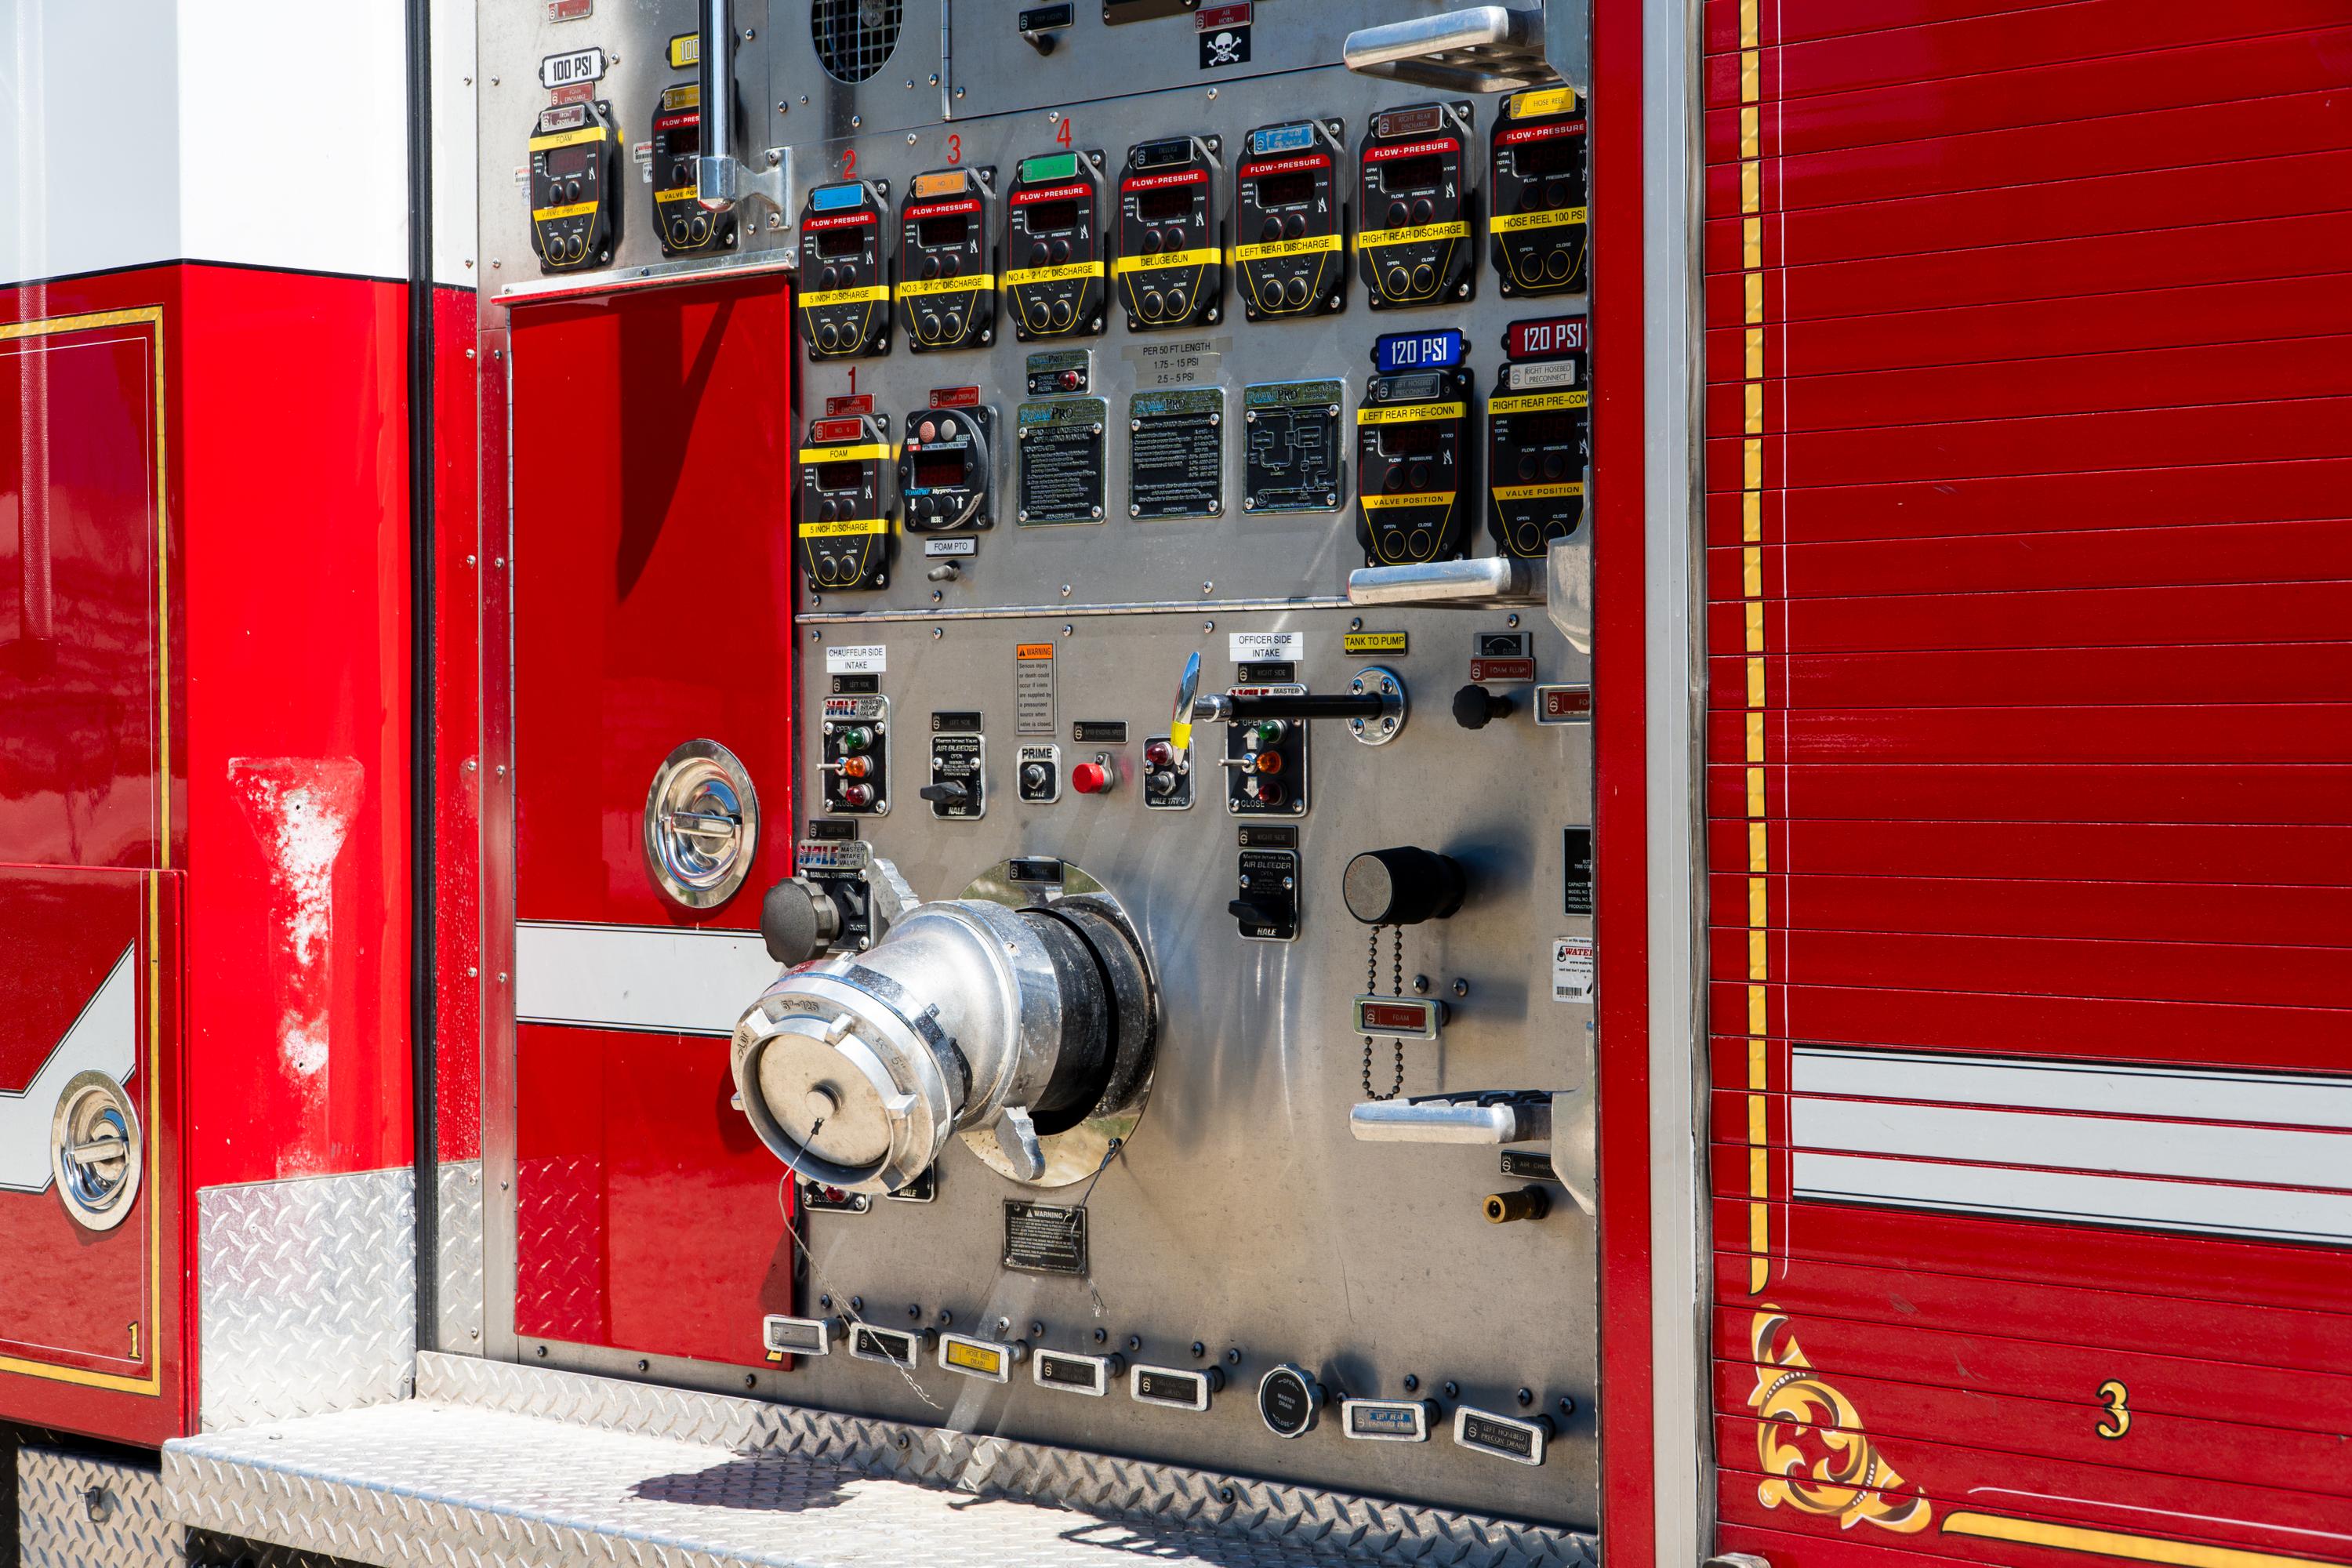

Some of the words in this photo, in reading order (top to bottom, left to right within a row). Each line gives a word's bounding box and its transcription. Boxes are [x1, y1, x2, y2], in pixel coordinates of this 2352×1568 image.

[553, 60, 571, 82] 100
[575, 57, 592, 79] PSI
[564, 93, 586, 103] DISCHARGE
[1534, 98, 1549, 107] HOSE
[1401, 121, 1428, 131] DISCHARGE
[1056, 118, 1073, 149] 4
[556, 135, 573, 145] FOAM
[947, 134, 961, 165] 3
[841, 149, 857, 180] 2
[664, 191, 684, 200] VALVE
[1504, 216, 1528, 227] HOSE
[1530, 212, 1552, 225] REEL
[1554, 211, 1570, 222] 100
[1571, 209, 1585, 220] PSI
[1362, 233, 1388, 245] RIGHT
[1389, 230, 1412, 241] REAR
[1414, 223, 1462, 238] DISCHARGE
[1240, 246, 1259, 257] LEFT
[1261, 243, 1283, 255] REAR
[1284, 238, 1330, 253] DISCHARGE
[1141, 255, 1171, 267] DELUGE
[1172, 253, 1189, 263] GUN
[1032, 270, 1036, 279] 2
[1051, 265, 1093, 277] DISCHARGE
[943, 278, 982, 289] DISCHARGE
[809, 295, 814, 303] 5
[815, 293, 830, 303] INCH
[832, 290, 869, 302] DISCHARGE
[1524, 326, 1550, 352] 120
[1555, 323, 1582, 349] PSI
[1160, 346, 1168, 354] 50
[1181, 342, 1210, 352] LENGTH
[1392, 339, 1417, 365] 120
[1422, 337, 1447, 362] PSI
[1154, 361, 1168, 369] 1.75
[1177, 359, 1185, 368] 15
[1187, 358, 1199, 366] PSI
[1525, 366, 1543, 375] RIGHT
[1545, 364, 1571, 372] HOSEBED
[848, 366, 855, 394] 1
[1176, 373, 1181, 382] 5
[1182, 372, 1194, 381] PSI
[1529, 374, 1566, 383] PRECONNECT
[1410, 379, 1433, 387] HOSEBED
[1396, 387, 1433, 396] PRECONNECT
[1493, 398, 1519, 411] RIGHT
[1521, 397, 1544, 408] REAR
[1547, 394, 1588, 407] PRE-CON
[1363, 411, 1384, 421] LEFT
[1385, 408, 1408, 420] REAR
[1410, 405, 1455, 418] PRE-CONN
[829, 449, 848, 459] FOAM
[1505, 488, 1534, 497] VALVE
[1537, 485, 1581, 496] POSITION
[1374, 498, 1400, 506] VALVE
[1403, 495, 1444, 505] POSITION
[931, 515, 943, 524] RESET
[810, 524, 815, 533] 5
[815, 524, 830, 533] INCH
[832, 522, 869, 532] DISCHARGE
[934, 543, 953, 551] FOAM
[954, 542, 968, 551] PTO
[1239, 635, 1272, 644] OFFICER
[1274, 635, 1292, 644] SIDE
[1345, 637, 1366, 646] TANK
[1367, 637, 1379, 645] TO
[1381, 636, 1404, 645] PUMP
[829, 648, 866, 658] CHAUFFEUR
[869, 648, 883, 656] SIDE
[1027, 647, 1051, 656] WARNING
[1252, 648, 1279, 657] INTAKE
[1503, 647, 1520, 655] CLOSED
[845, 661, 867, 670] INTAKE
[1490, 666, 1508, 674] FOAM
[1509, 666, 1527, 674] FLUSH
[1022, 748, 1052, 759] PRIME
[1240, 799, 1265, 808] CLOSE
[948, 806, 967, 815] HALE
[1257, 927, 1277, 937] HALE
[899, 1189, 916, 1197] HALE
[1034, 1210, 1063, 1219] WARNING
[127, 1320, 140, 1360] 1
[966, 1348, 978, 1358] HOSE
[980, 1352, 990, 1361] REEL
[970, 1358, 985, 1367] DRAIN
[1283, 1378, 1295, 1387] OPEN
[1277, 1392, 1295, 1404] MASTER
[1278, 1399, 1293, 1410] DRAIN
[2095, 1378, 2131, 1440] 3
[1275, 1416, 1290, 1428] CLOSE
[1376, 1412, 1388, 1421] LEFT
[1483, 1424, 1496, 1433] LEFT
[1497, 1427, 1525, 1442] HOSEBED
[1481, 1433, 1505, 1445] PRECON
[1507, 1439, 1526, 1451] DRAIN
